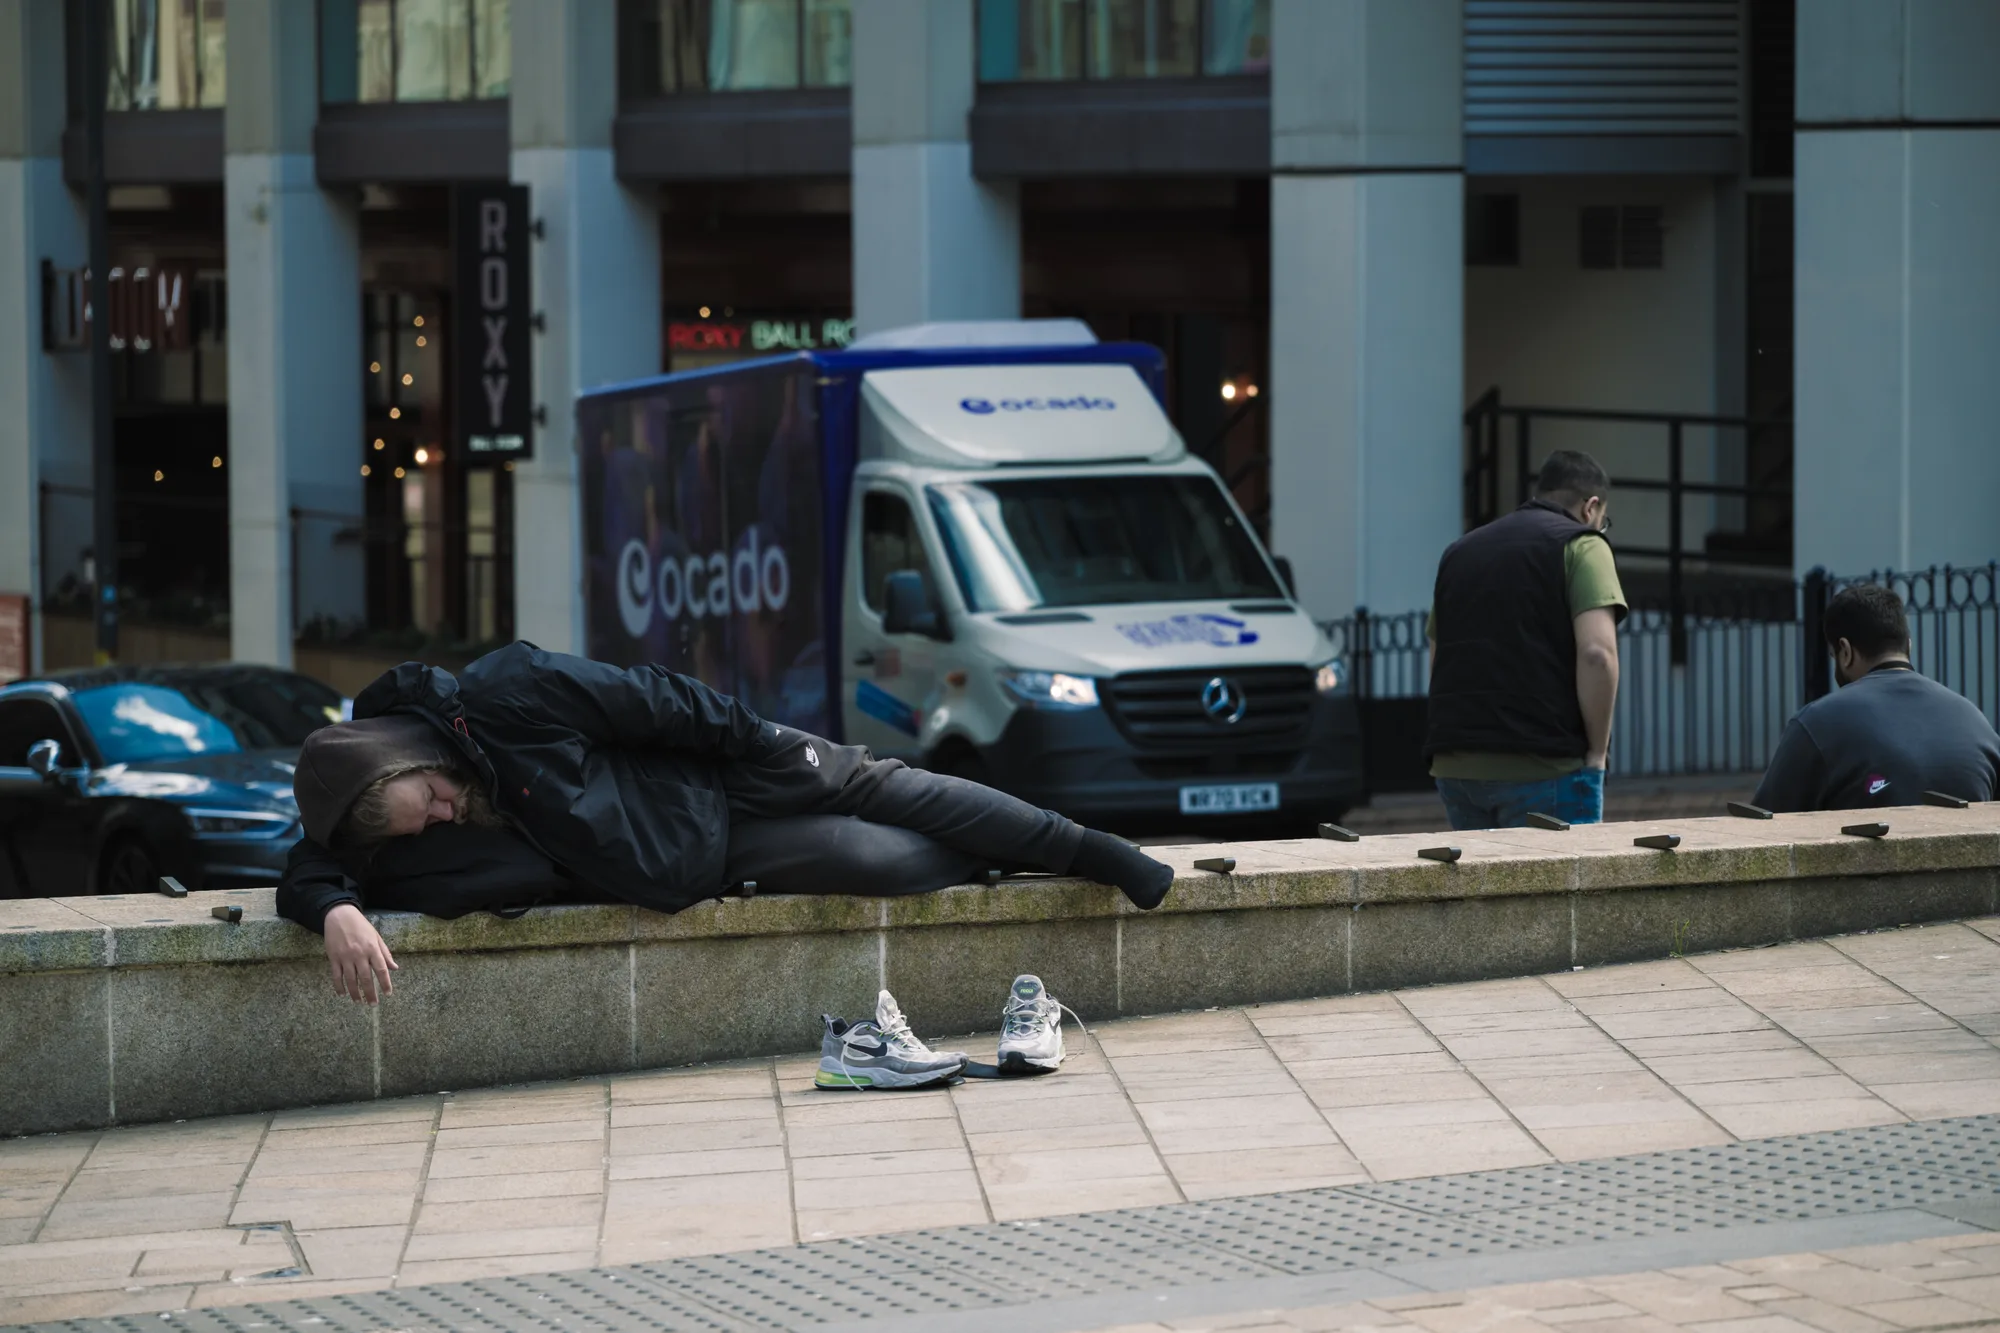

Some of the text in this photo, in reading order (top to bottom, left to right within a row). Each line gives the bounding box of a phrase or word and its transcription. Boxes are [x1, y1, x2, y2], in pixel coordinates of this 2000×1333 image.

[480, 199, 509, 428] ROXY
[669, 323, 744, 349] ROXY
[751, 320, 816, 349] BALL
[1000, 394, 1116, 412] ocado
[658, 524, 789, 620] ocado
